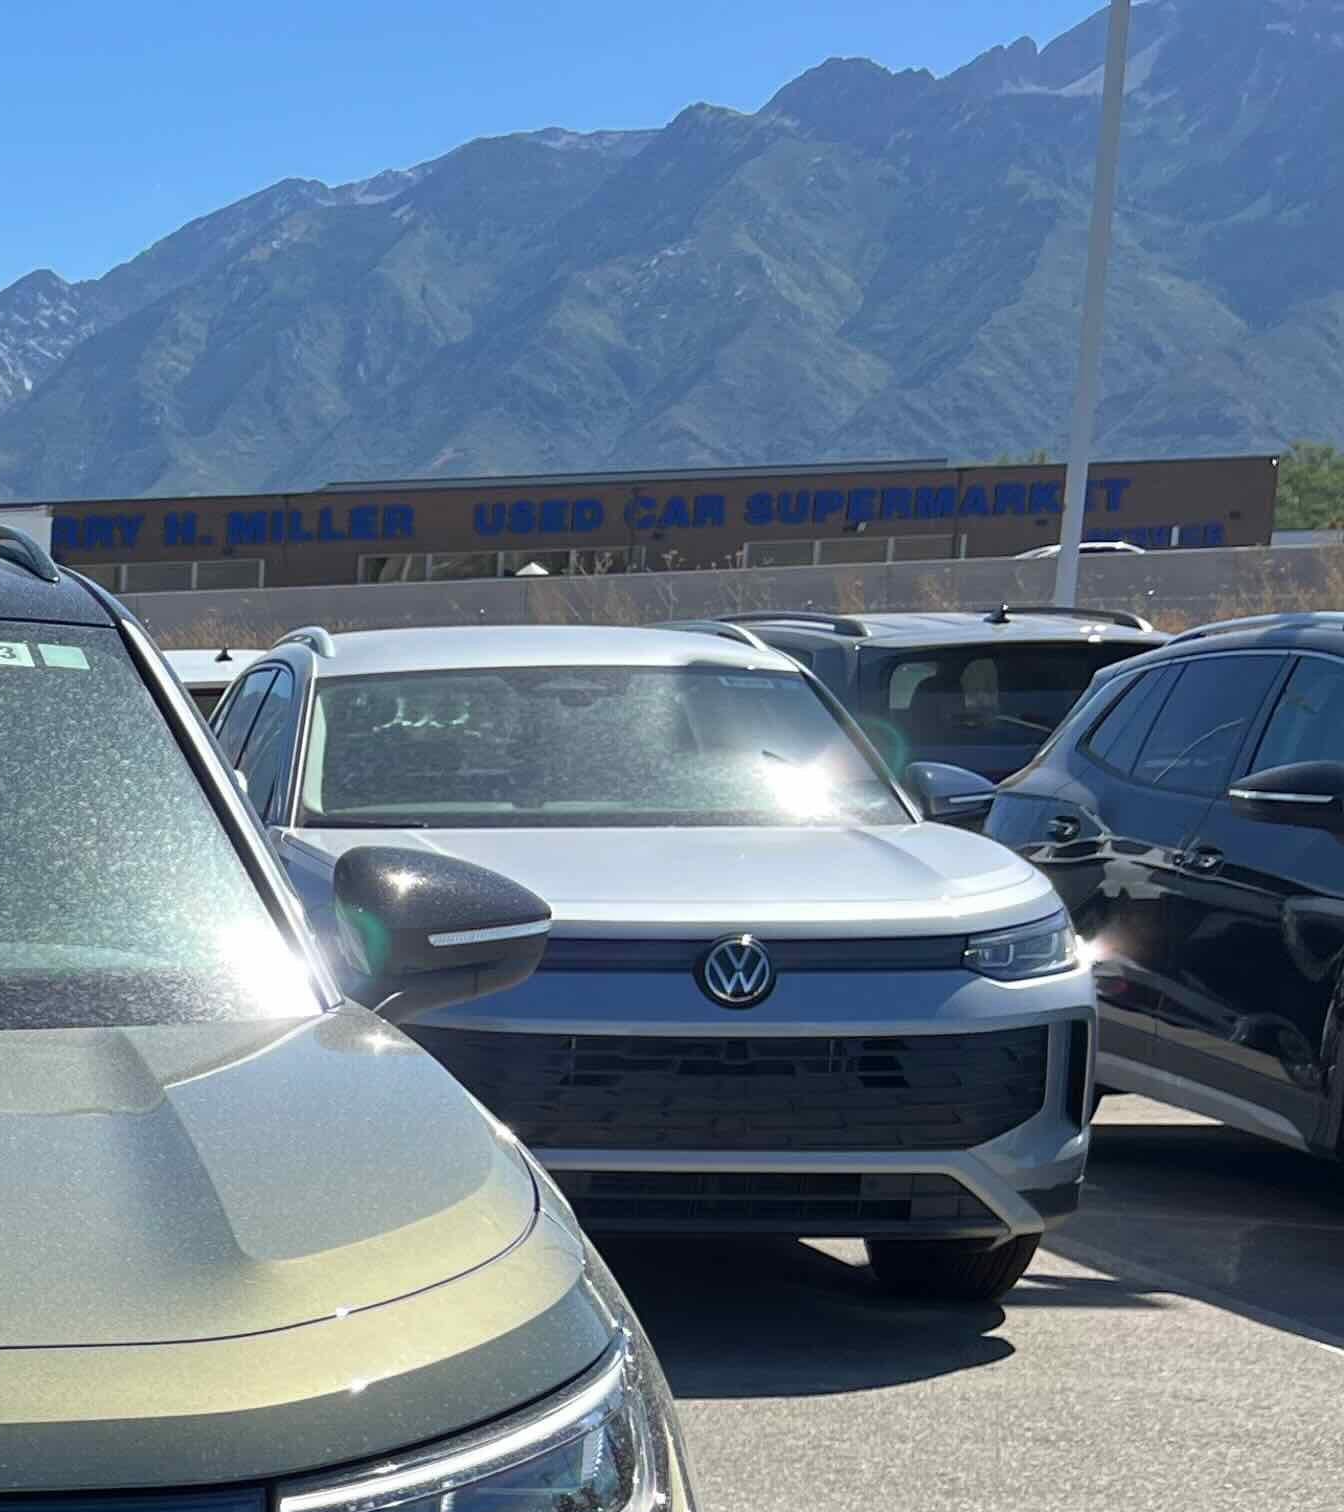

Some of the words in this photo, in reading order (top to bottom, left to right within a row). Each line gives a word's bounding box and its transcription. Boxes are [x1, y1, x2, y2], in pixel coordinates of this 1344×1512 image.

[164, 511, 213, 546] H.
[227, 503, 416, 546] MILLER
[475, 499, 605, 536] USED
[623, 494, 727, 530] CAR
